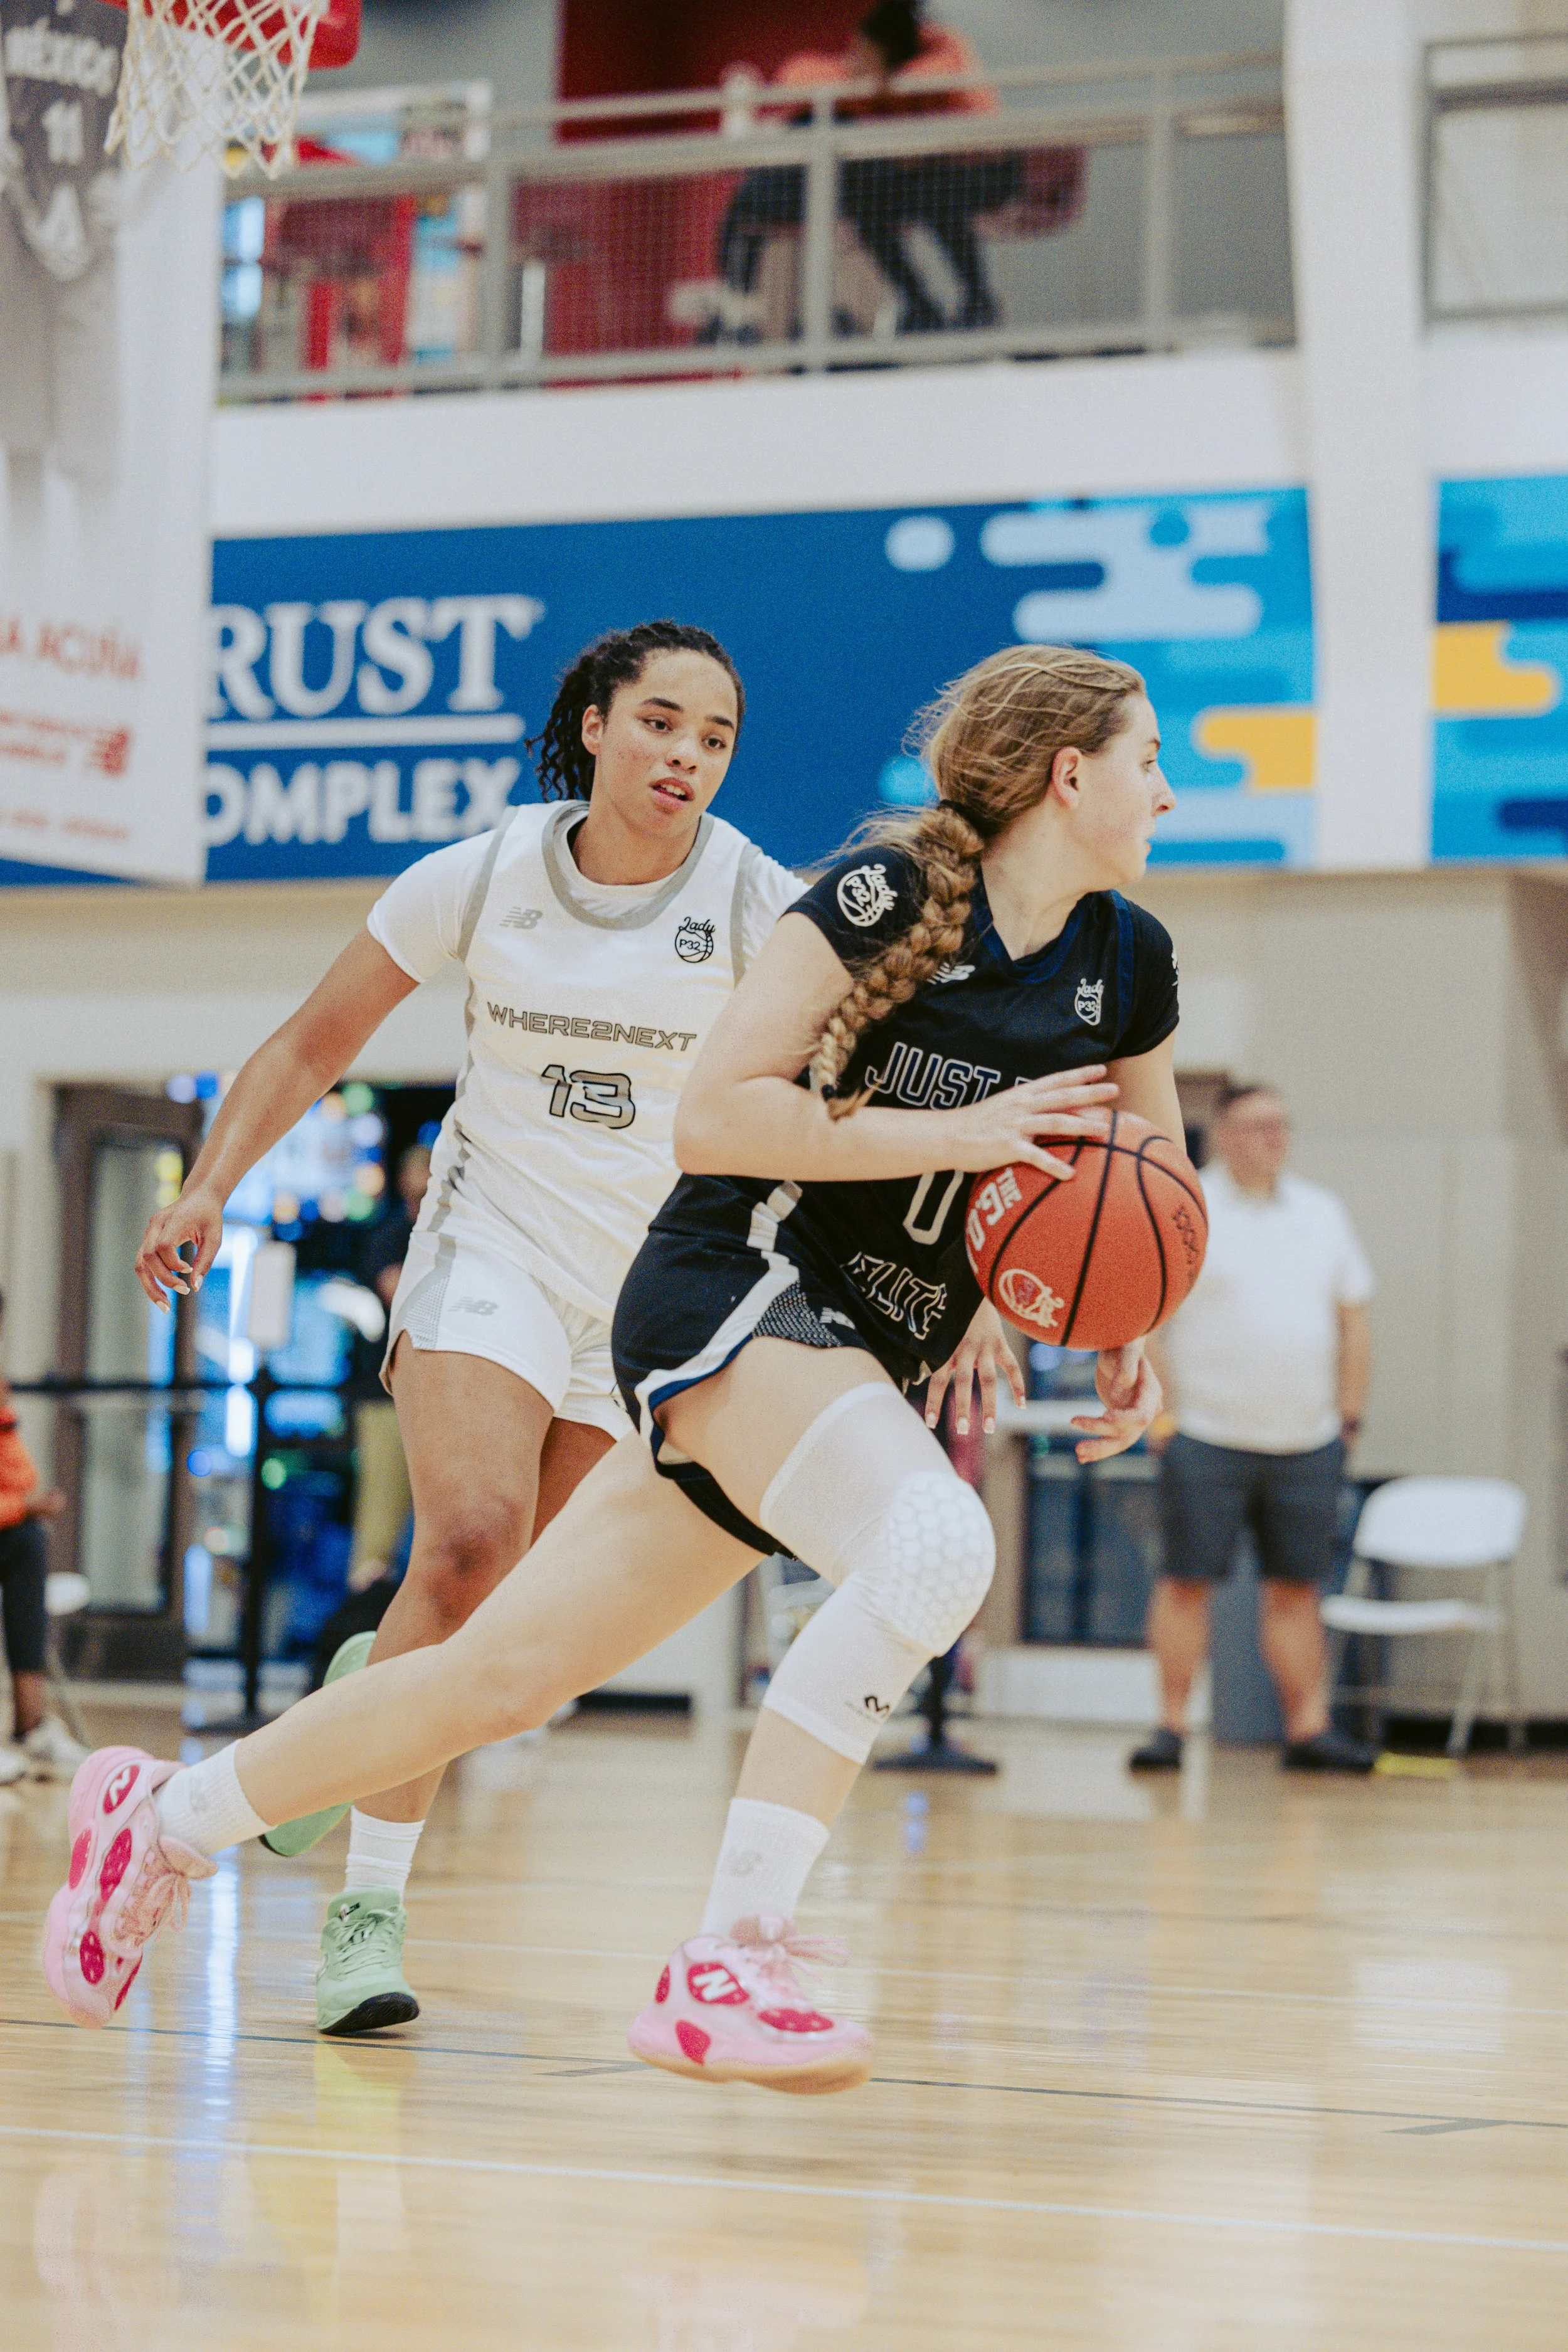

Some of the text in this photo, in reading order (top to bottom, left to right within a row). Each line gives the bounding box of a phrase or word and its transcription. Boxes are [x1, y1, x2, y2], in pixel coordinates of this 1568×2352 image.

[209, 594, 544, 720] RUST
[206, 756, 520, 847] OMPLEX
[679, 916, 716, 937] Lady
[679, 939, 701, 953] P32
[487, 1002, 697, 1052] WHERE2NEXT
[540, 1064, 635, 1130] 13
[865, 1041, 1002, 1111] JUST
